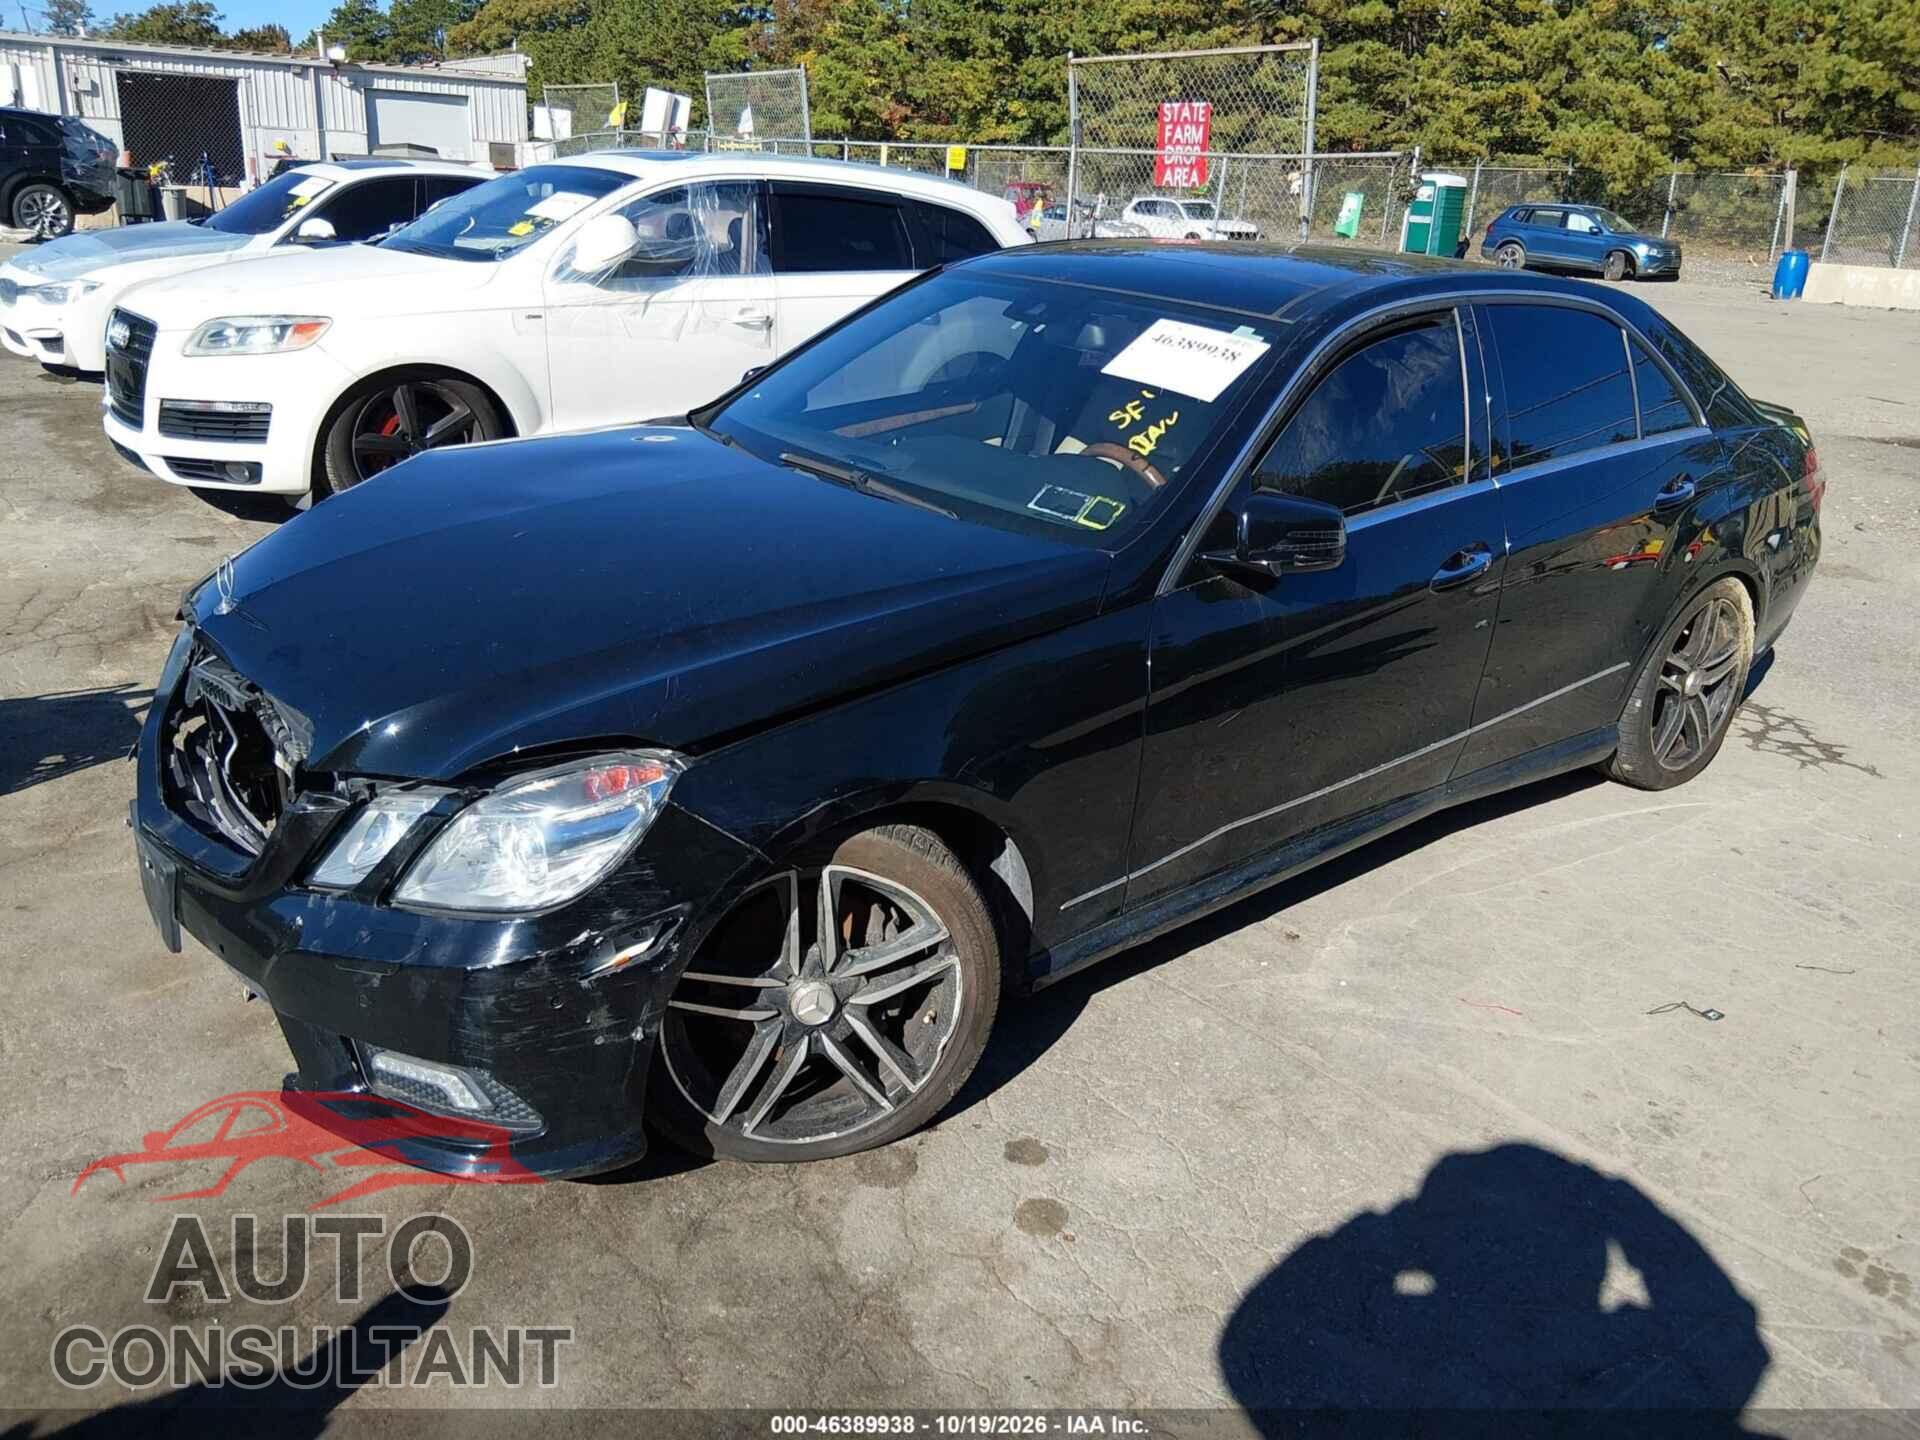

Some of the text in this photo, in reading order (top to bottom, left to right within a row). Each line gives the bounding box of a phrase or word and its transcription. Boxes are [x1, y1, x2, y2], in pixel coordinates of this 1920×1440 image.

[1163, 102, 1206, 122] STATE
[1164, 124, 1203, 144] FARM
[1162, 167, 1199, 187] AREA
